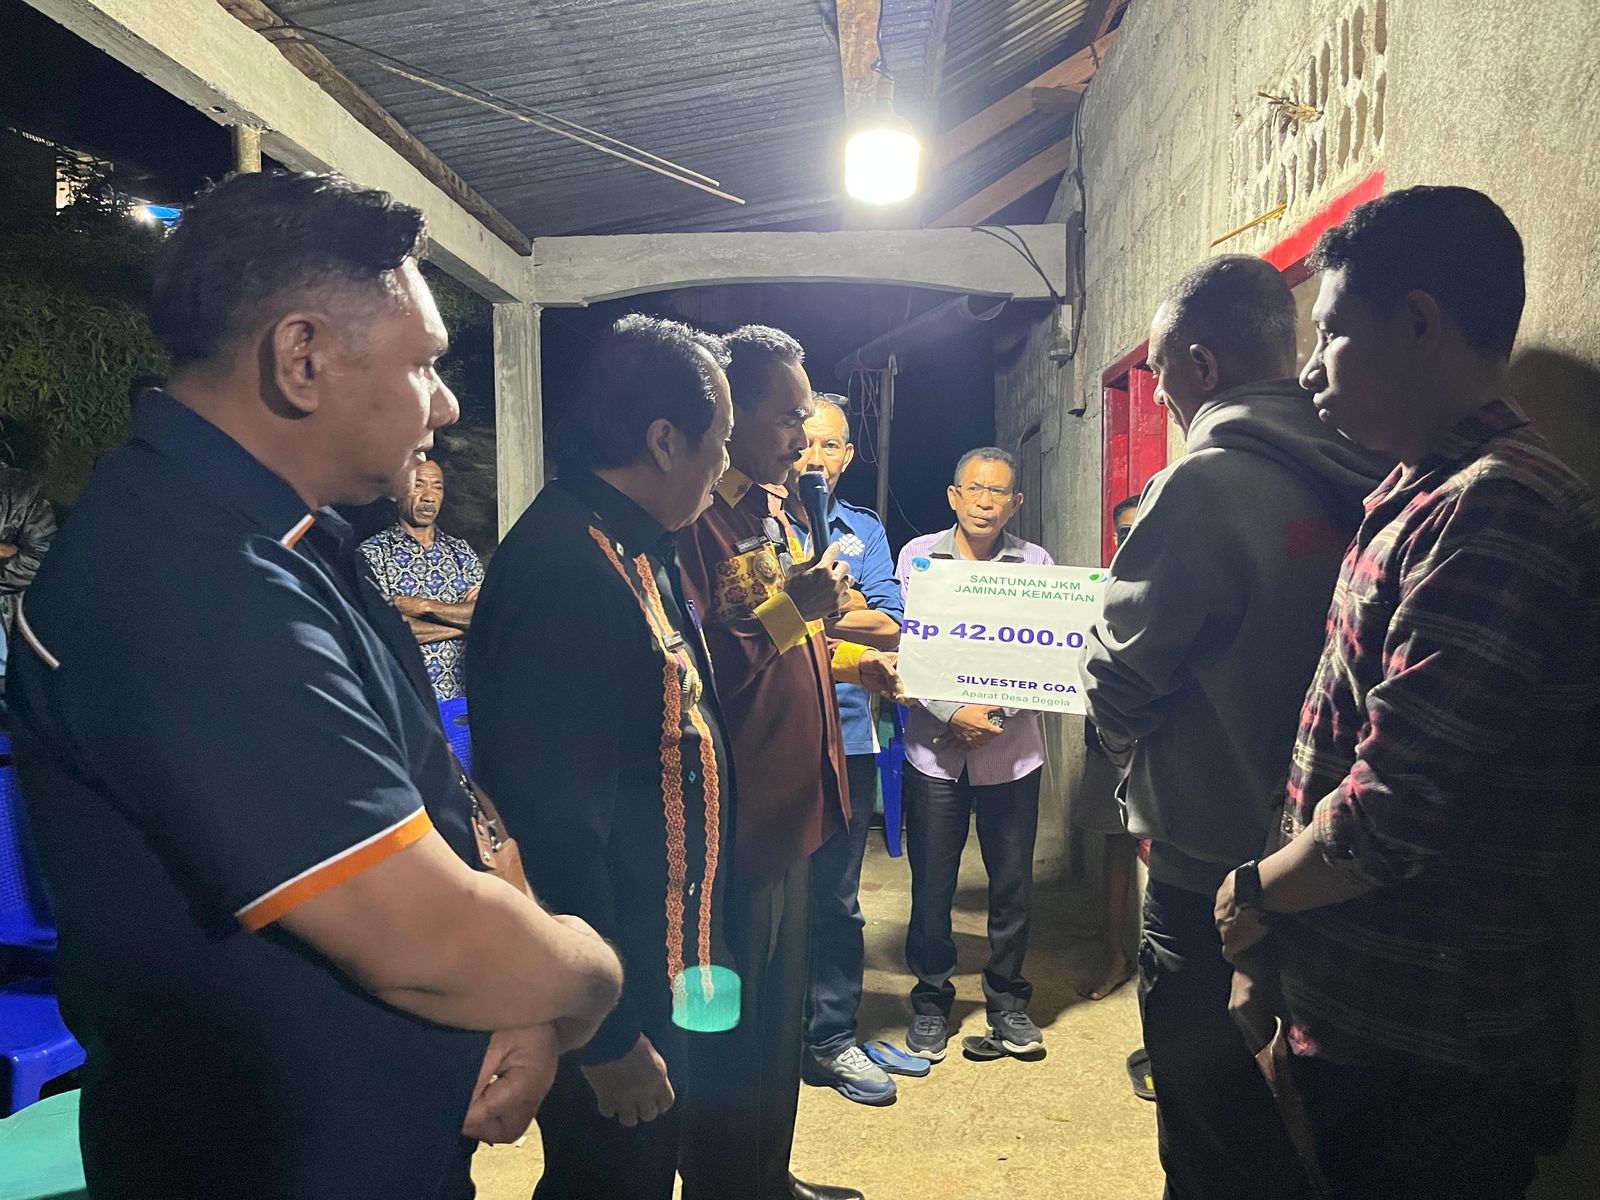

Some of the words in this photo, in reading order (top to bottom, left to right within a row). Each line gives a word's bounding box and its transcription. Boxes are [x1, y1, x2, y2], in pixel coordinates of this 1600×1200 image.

[970, 575, 1046, 588] SANTUNAN
[1051, 581, 1080, 590] JKM
[954, 585, 1017, 596] JAMINAN
[1022, 590, 1095, 602] KEMATIAN
[901, 619, 939, 639] Rp
[950, 623, 1084, 649] 42.000.0
[957, 675, 1038, 690] SILVESTER
[1043, 684, 1077, 693] GOA
[961, 690, 997, 700] Aparat
[1002, 693, 1028, 702] Desa
[1032, 695, 1070, 707] Degela
